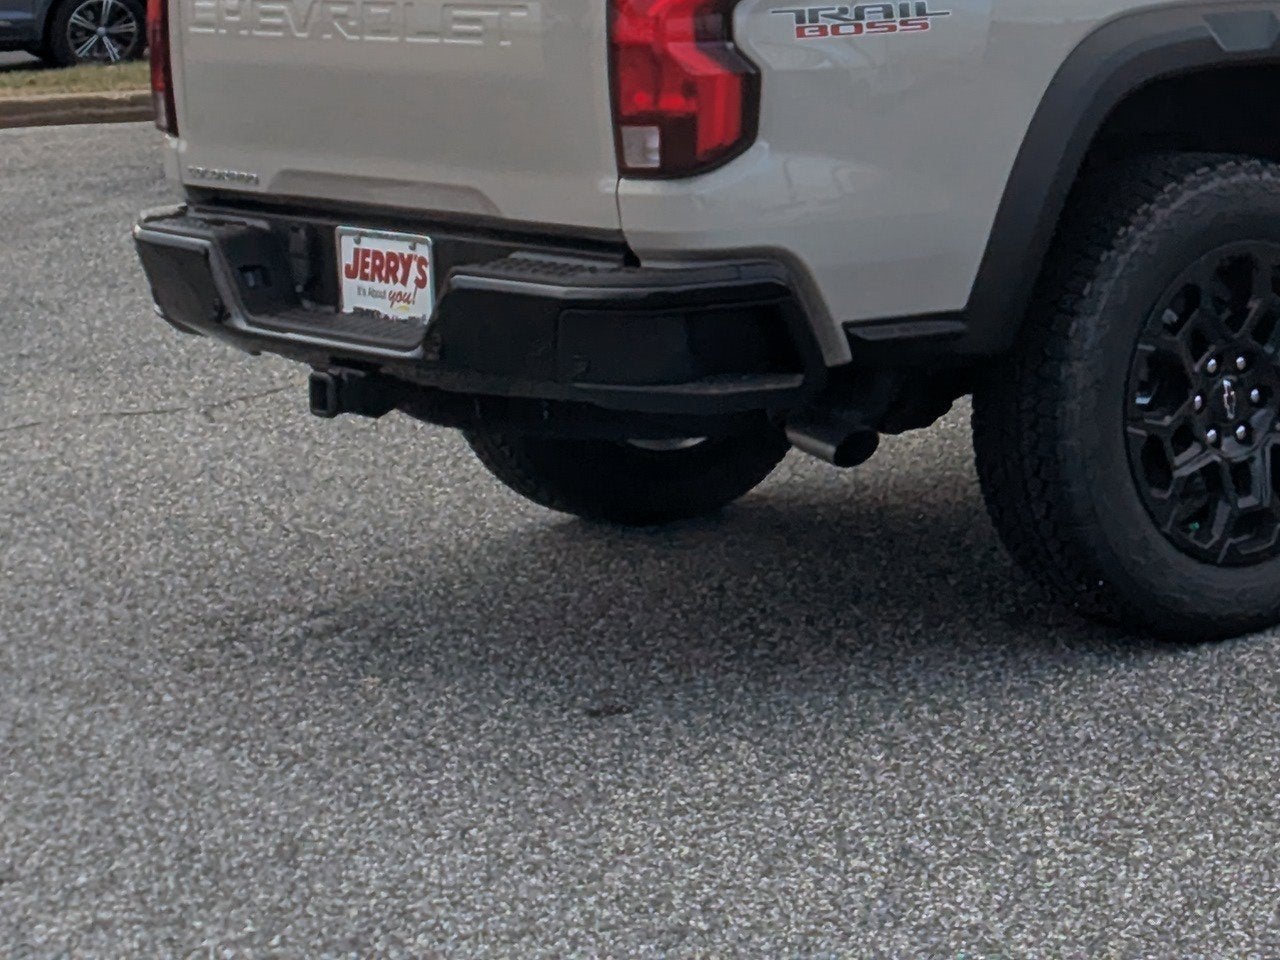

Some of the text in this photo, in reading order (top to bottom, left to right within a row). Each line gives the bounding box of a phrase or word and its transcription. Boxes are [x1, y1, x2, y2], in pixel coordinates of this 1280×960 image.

[771, 1, 950, 24] TRAIL
[796, 16, 930, 39] BOSS
[344, 247, 429, 289] JERRY'S
[388, 287, 418, 309] you!
